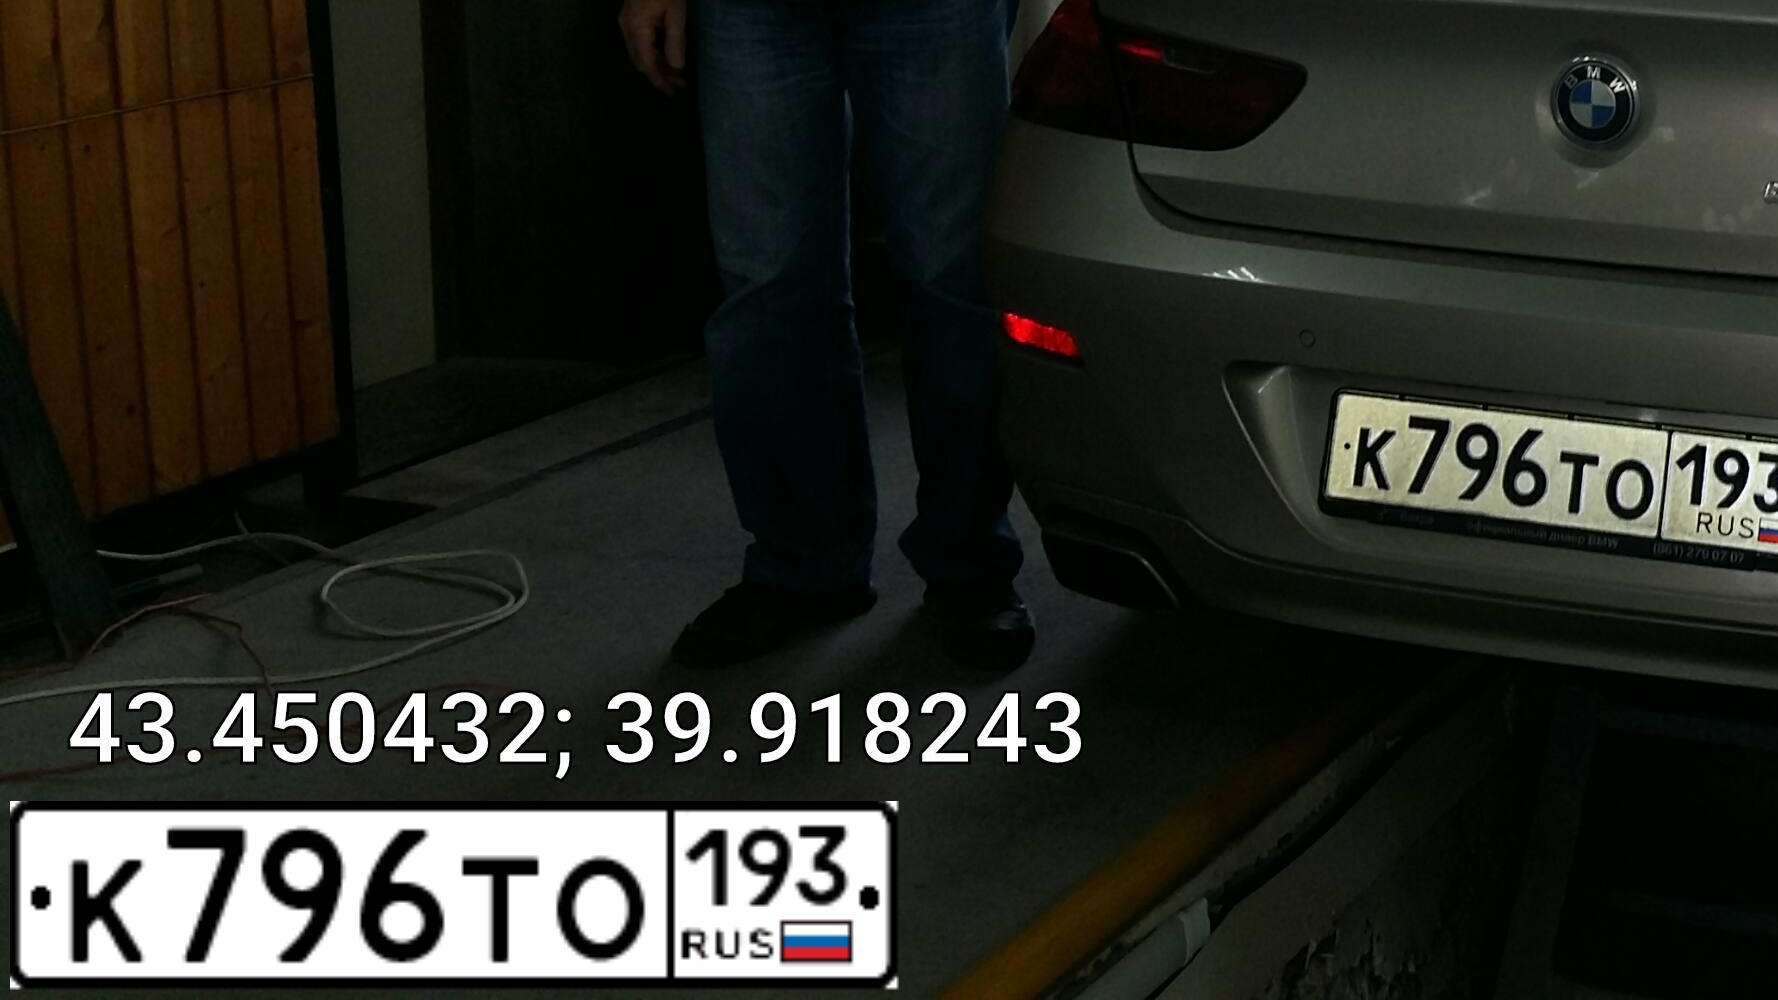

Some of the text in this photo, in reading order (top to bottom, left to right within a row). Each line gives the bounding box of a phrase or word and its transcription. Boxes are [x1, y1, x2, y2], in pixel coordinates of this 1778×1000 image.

[1564, 65, 1626, 93] BMW
[1352, 415, 1656, 521] К796ТО
[1695, 511, 1756, 541] RUS
